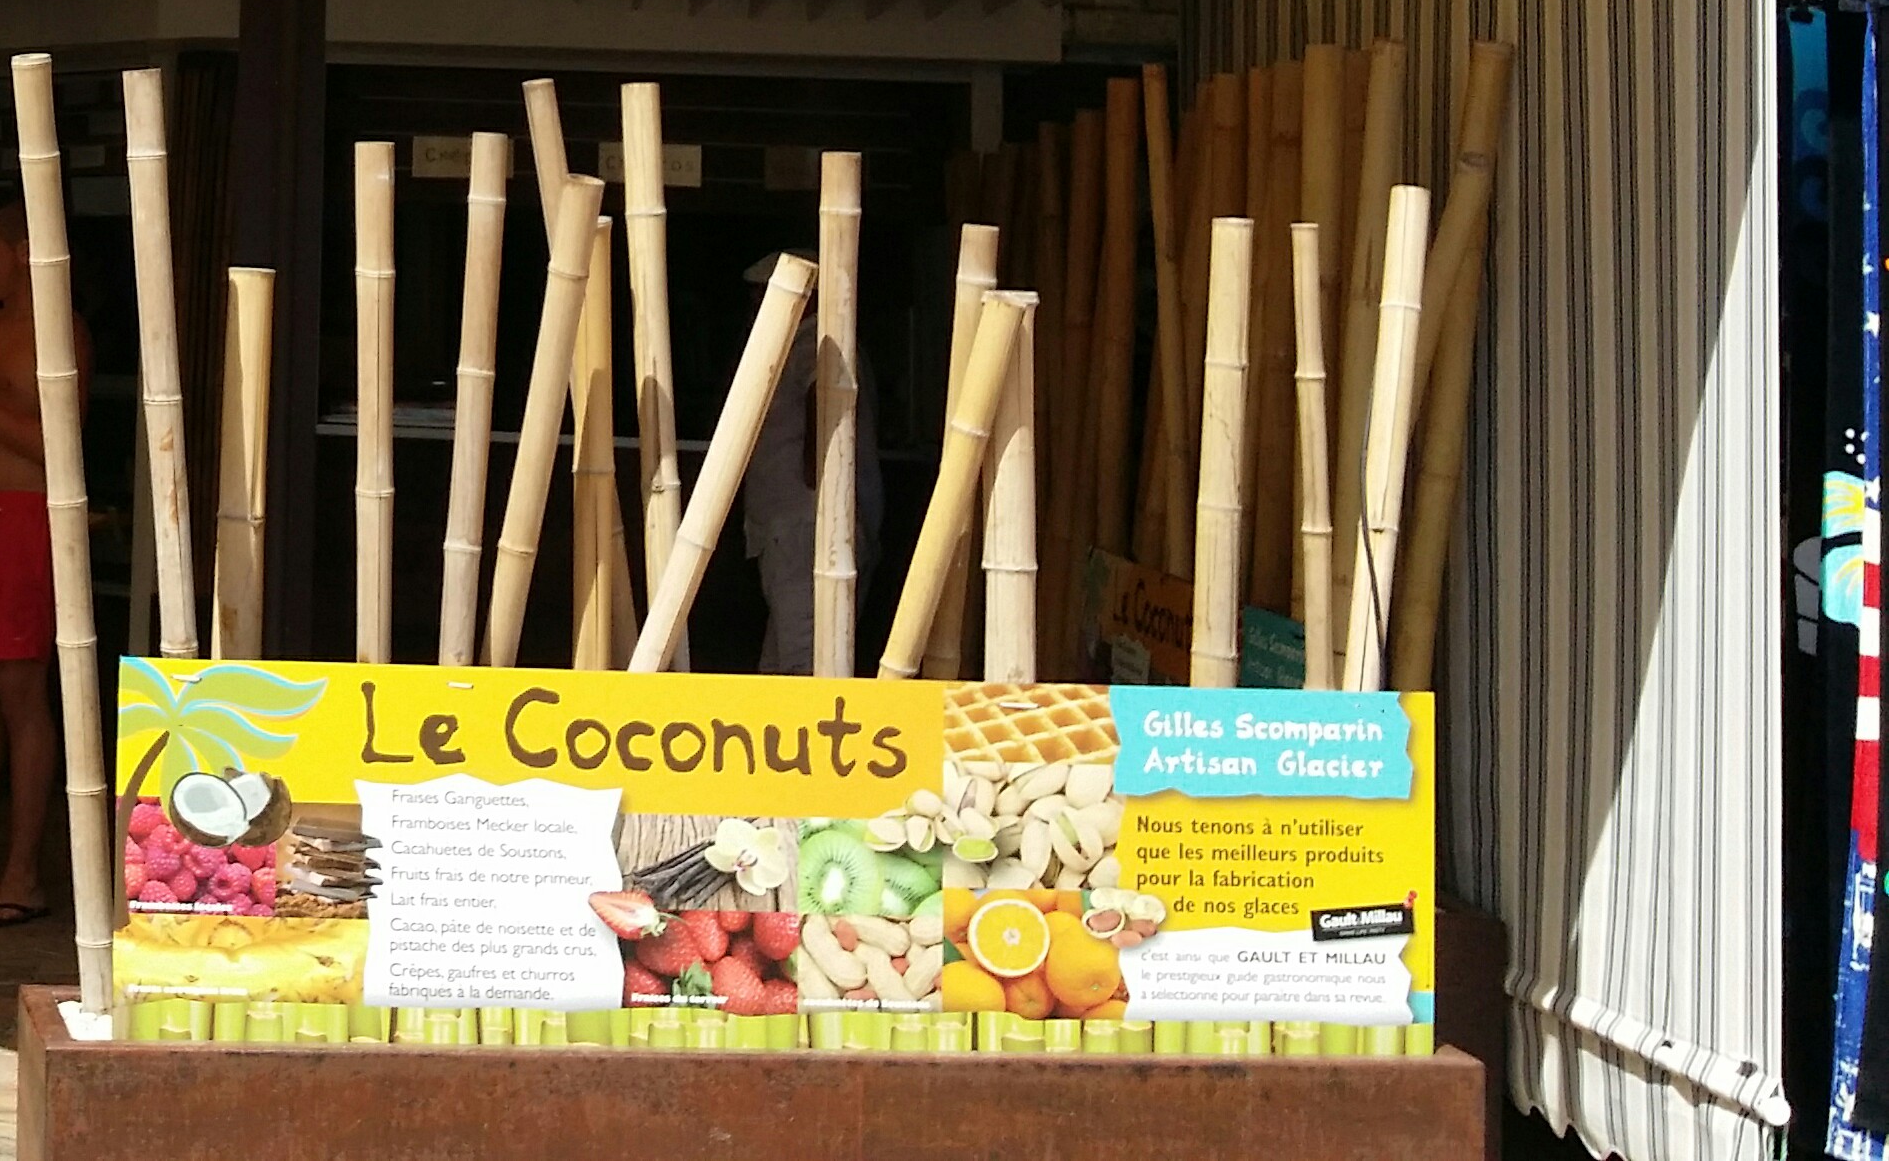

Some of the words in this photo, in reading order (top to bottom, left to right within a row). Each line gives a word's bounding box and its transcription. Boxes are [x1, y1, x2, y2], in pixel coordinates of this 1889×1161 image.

[361, 681, 466, 765] Le
[505, 687, 907, 777] Coconuts
[1143, 710, 1224, 738] Gilles
[1235, 713, 1382, 747] Scomparin
[1144, 747, 1256, 775] Artisan
[1277, 750, 1383, 778] Glacier
[391, 788, 440, 805] Fraises
[392, 815, 471, 830] Framboises
[476, 817, 529, 833] Mecker
[1137, 815, 1183, 834] Nous
[1191, 818, 1255, 835] tenons
[1261, 817, 1273, 836] à
[1280, 818, 1364, 837] n'utiliser
[477, 843, 495, 858] de
[499, 843, 567, 860] Soustons,
[1136, 846, 1171, 865] que
[1179, 842, 1204, 861] les
[1211, 843, 1298, 862] meilleurs
[1305, 845, 1384, 868] produits
[390, 865, 431, 881] Fruits
[434, 866, 464, 882] frais
[468, 870, 486, 883] de
[490, 873, 530, 884] notre
[1136, 873, 1182, 892] pour
[1189, 868, 1205, 887] la
[1212, 869, 1314, 889] fabrication
[390, 891, 416, 907] Lait
[419, 892, 449, 908] frais
[1173, 895, 1196, 913] de
[1203, 900, 1236, 914] nos
[1243, 896, 1300, 920] glaces
[389, 917, 438, 934] Cacao,
[475, 921, 494, 935] de
[497, 924, 555, 936] noisette
[559, 926, 574, 937] et
[578, 923, 597, 938] de
[389, 938, 447, 954] pistache
[451, 939, 476, 954] des
[480, 940, 508, 957] plus
[512, 942, 559, 959] grands
[1175, 952, 1202, 963] ainsi
[1207, 953, 1231, 965] que
[1237, 950, 1291, 964] GAULT
[1298, 951, 1318, 964] ET
[1325, 952, 1386, 965] MILLAU
[446, 964, 498, 983] gaufres
[501, 969, 517, 980] et
[520, 968, 576, 982] churros
[1141, 968, 1152, 981] le
[1156, 971, 1221, 985] prestigieux
[1225, 970, 1259, 986] guide
[1262, 973, 1353, 987] gastronomique
[1357, 974, 1387, 985] nous
[469, 984, 481, 1000] la
[1221, 991, 1251, 1005] pour
[1303, 990, 1331, 1003] dans
[1334, 993, 1347, 1003] sa
